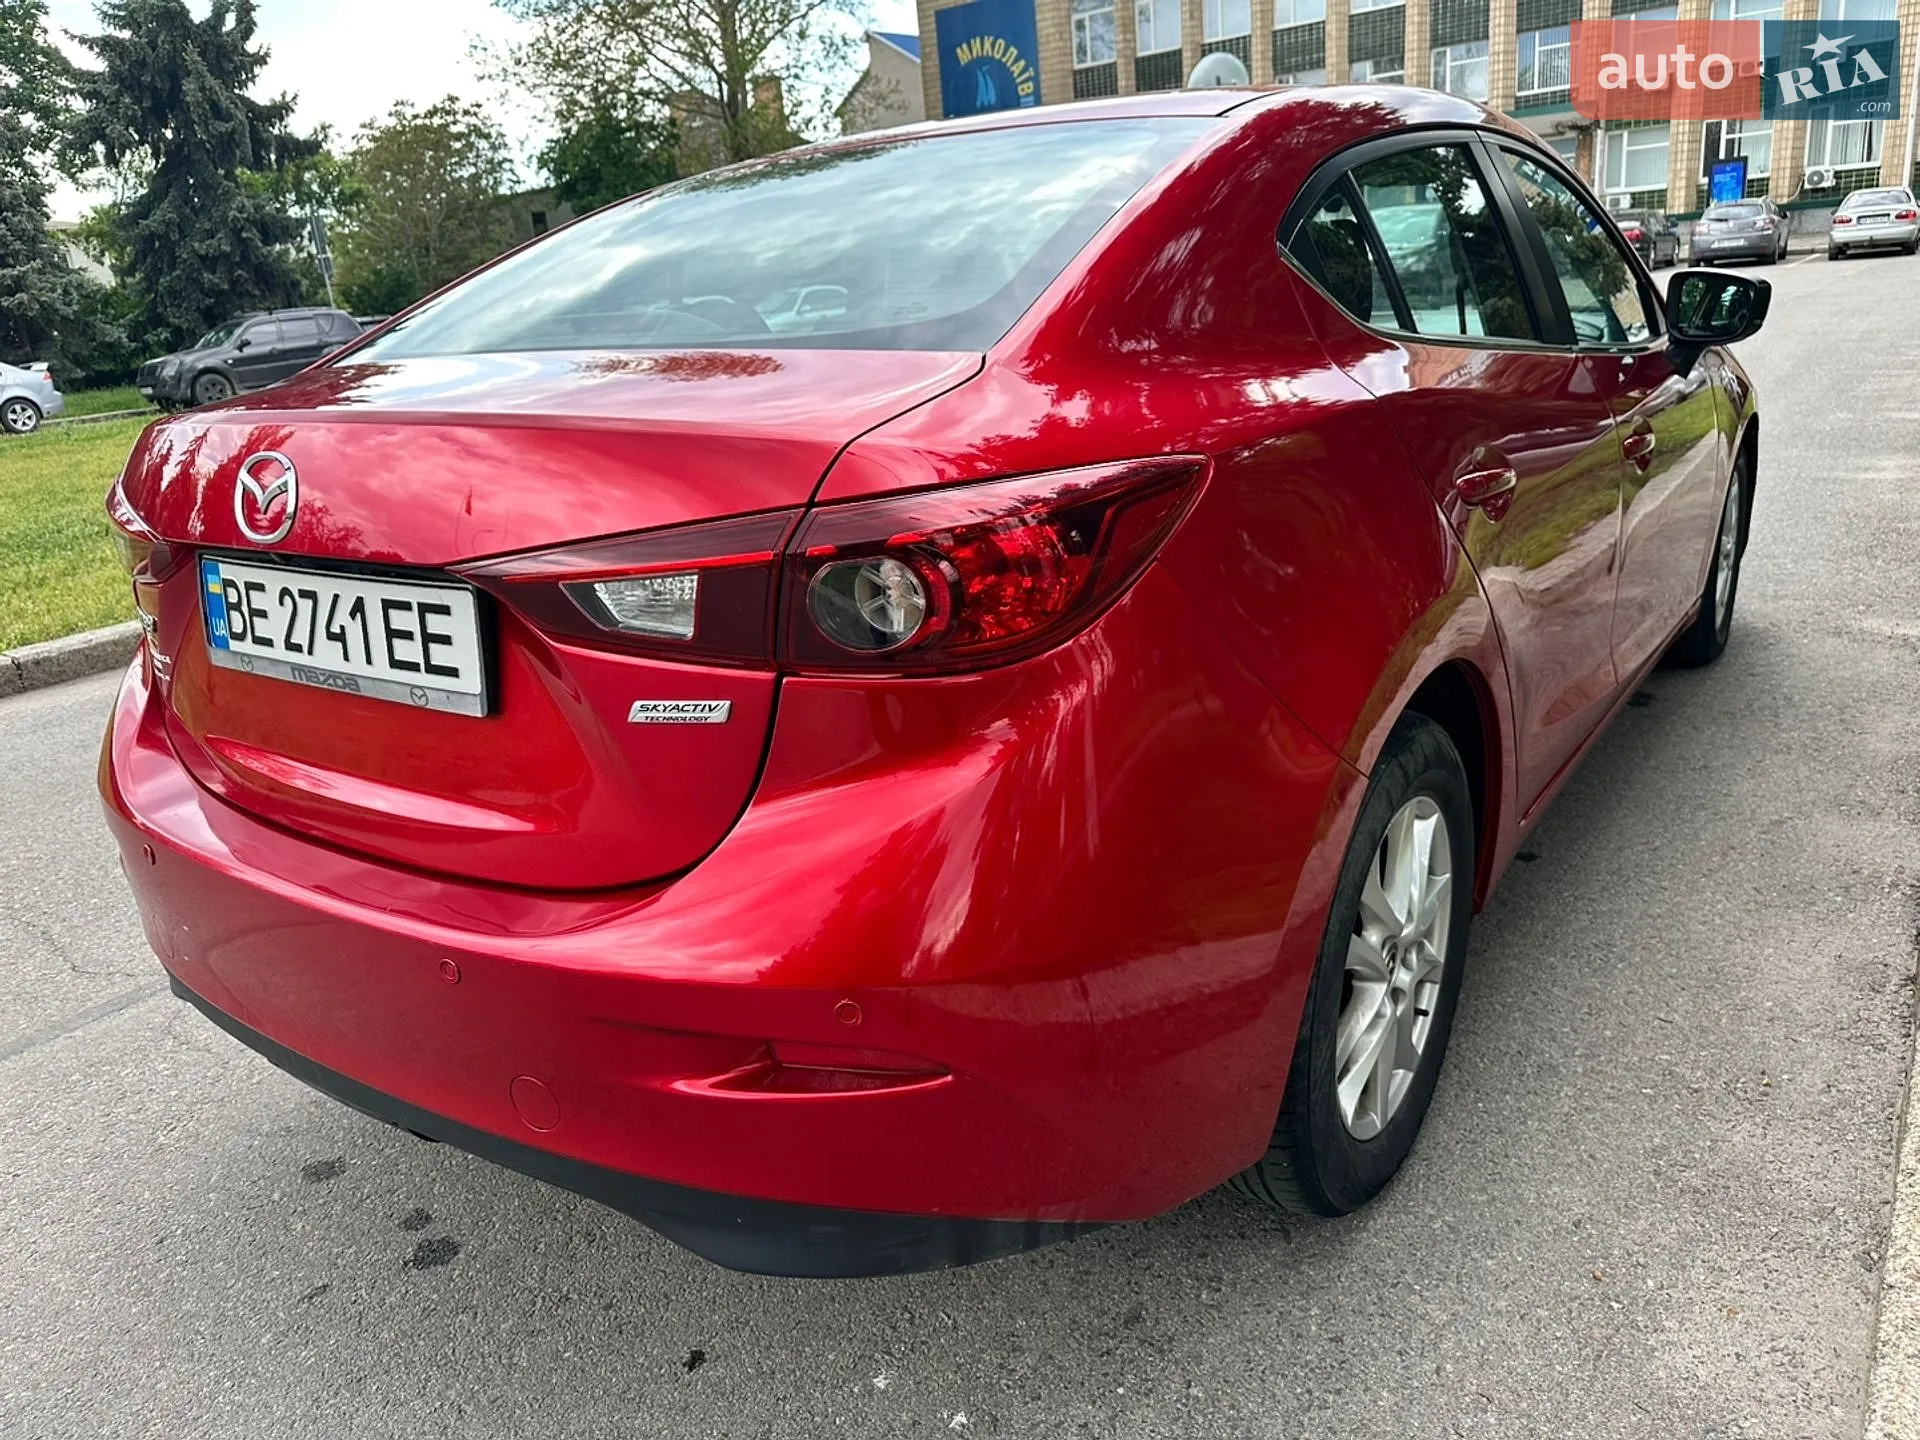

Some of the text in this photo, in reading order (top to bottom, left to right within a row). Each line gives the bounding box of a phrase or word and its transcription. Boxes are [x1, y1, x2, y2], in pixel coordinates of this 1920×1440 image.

[955, 36, 1035, 96] МИКОЛАЇВ
[212, 617, 228, 637] UA
[222, 577, 460, 679] BE 2741 EE
[638, 703, 720, 713] SKYACTIV
